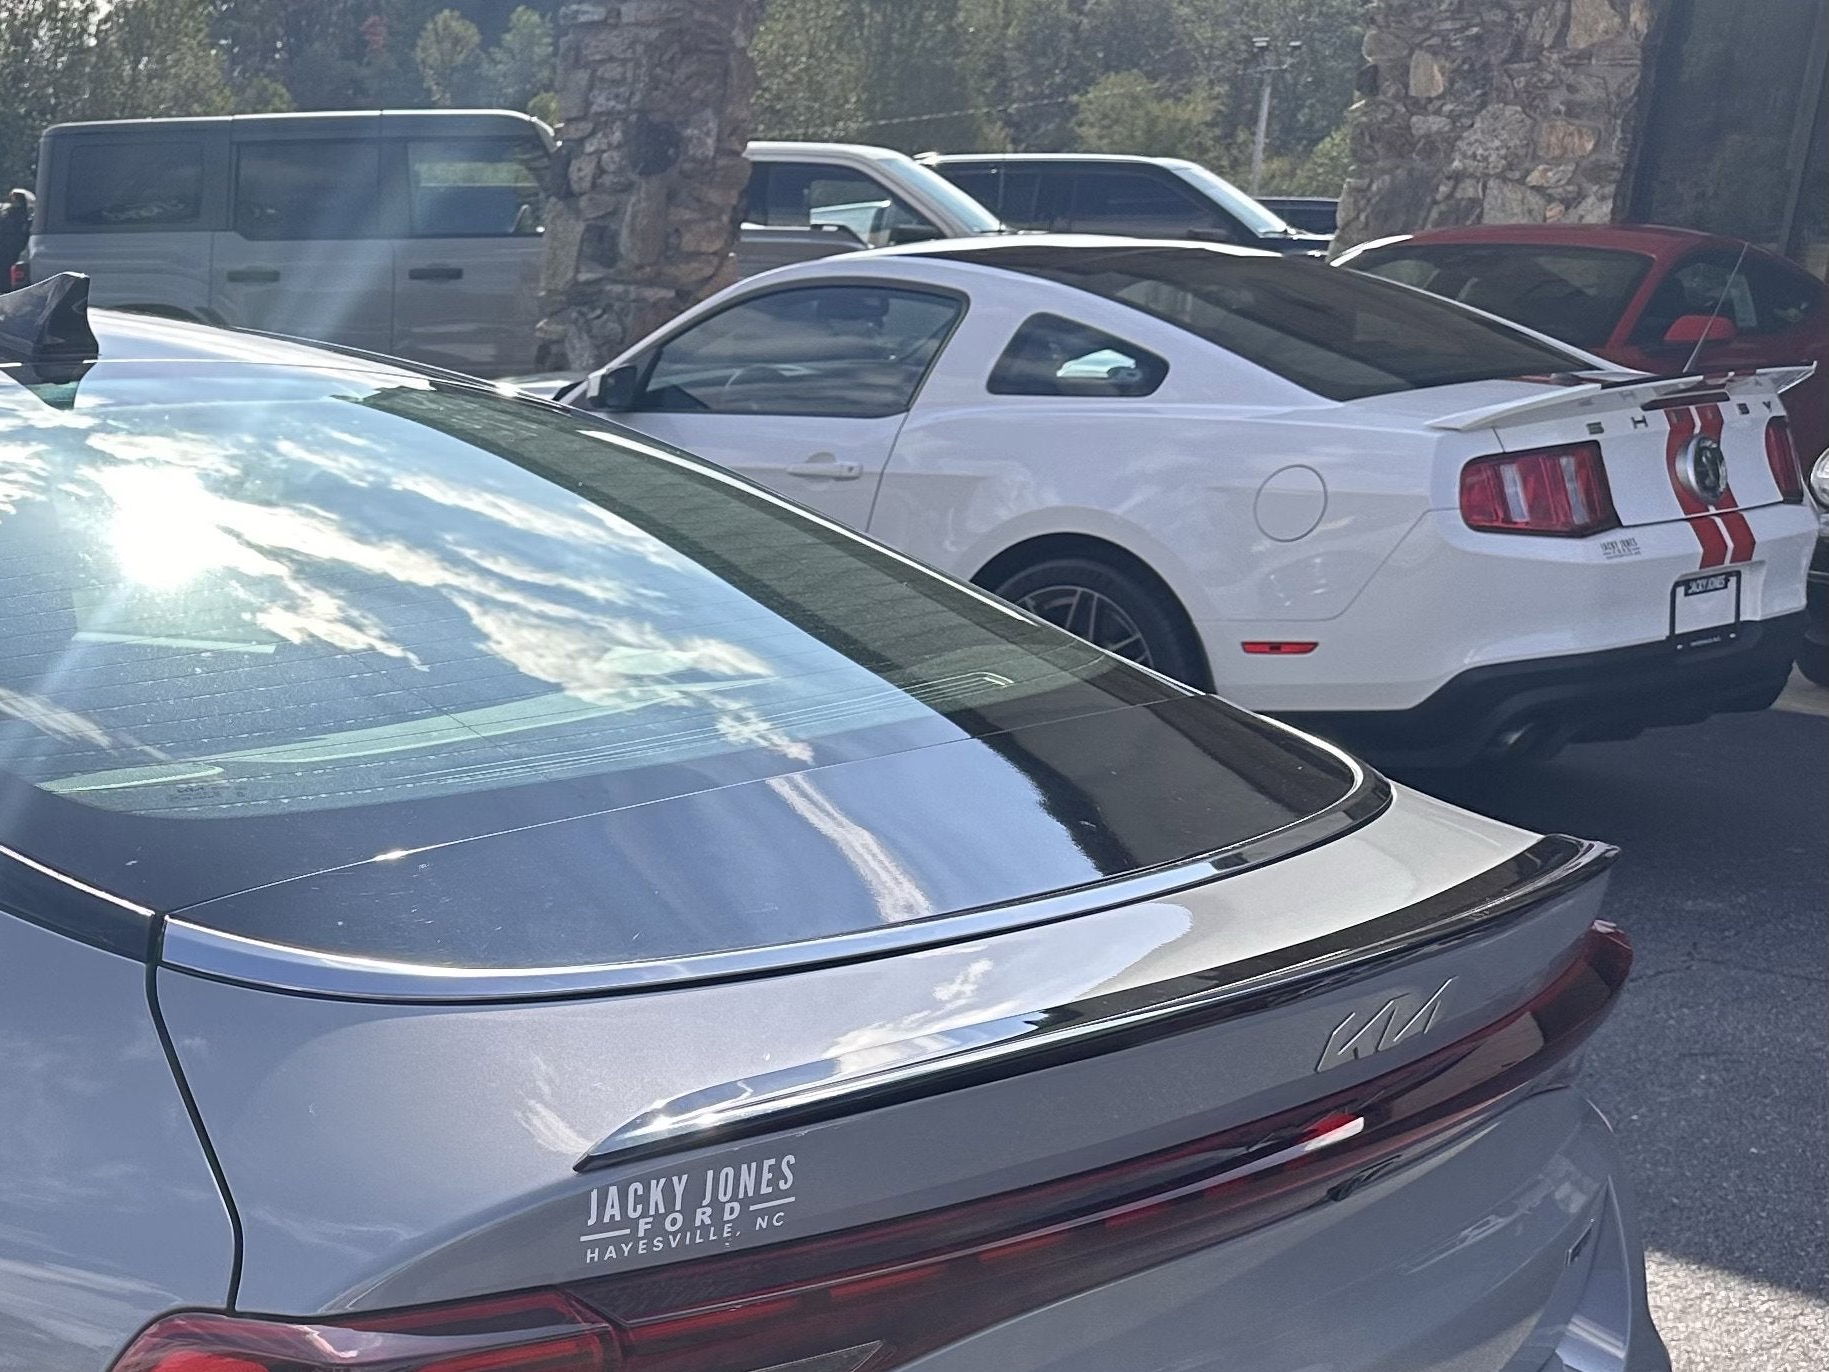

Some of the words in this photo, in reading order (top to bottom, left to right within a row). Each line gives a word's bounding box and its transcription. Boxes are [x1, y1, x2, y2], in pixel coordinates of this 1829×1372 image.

[587, 1173, 689, 1227] JACKY
[701, 1154, 796, 1207] JONES
[586, 1222, 741, 1264] HAYESVILLE,
[755, 1212, 785, 1230] NC
[637, 1201, 741, 1238] FORD
